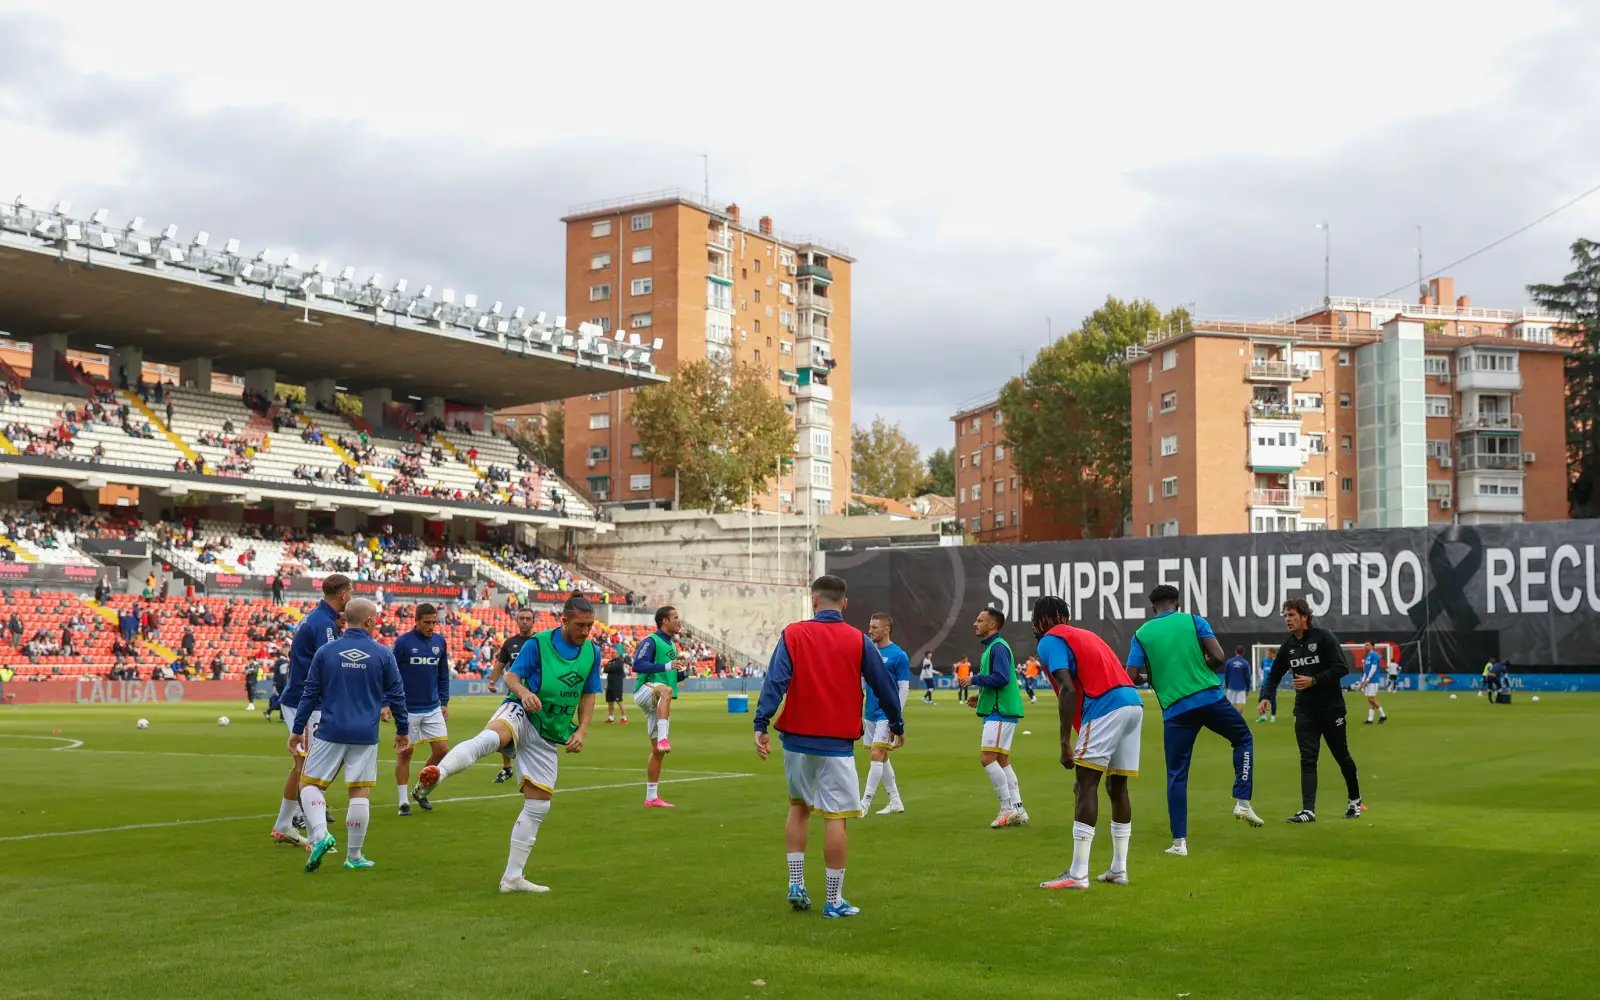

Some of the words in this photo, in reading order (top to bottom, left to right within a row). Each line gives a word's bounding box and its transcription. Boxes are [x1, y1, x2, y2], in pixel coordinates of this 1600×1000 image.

[988, 559, 1146, 622] SIEMPRE
[1157, 557, 1208, 617] EN
[1222, 550, 1424, 618] NUESTRO
[341, 661, 367, 669] umbro
[1290, 655, 1320, 668] DIGI
[76, 679, 157, 704] LALIGA
[510, 705, 525, 720] 12
[1241, 751, 1250, 781] umbro
